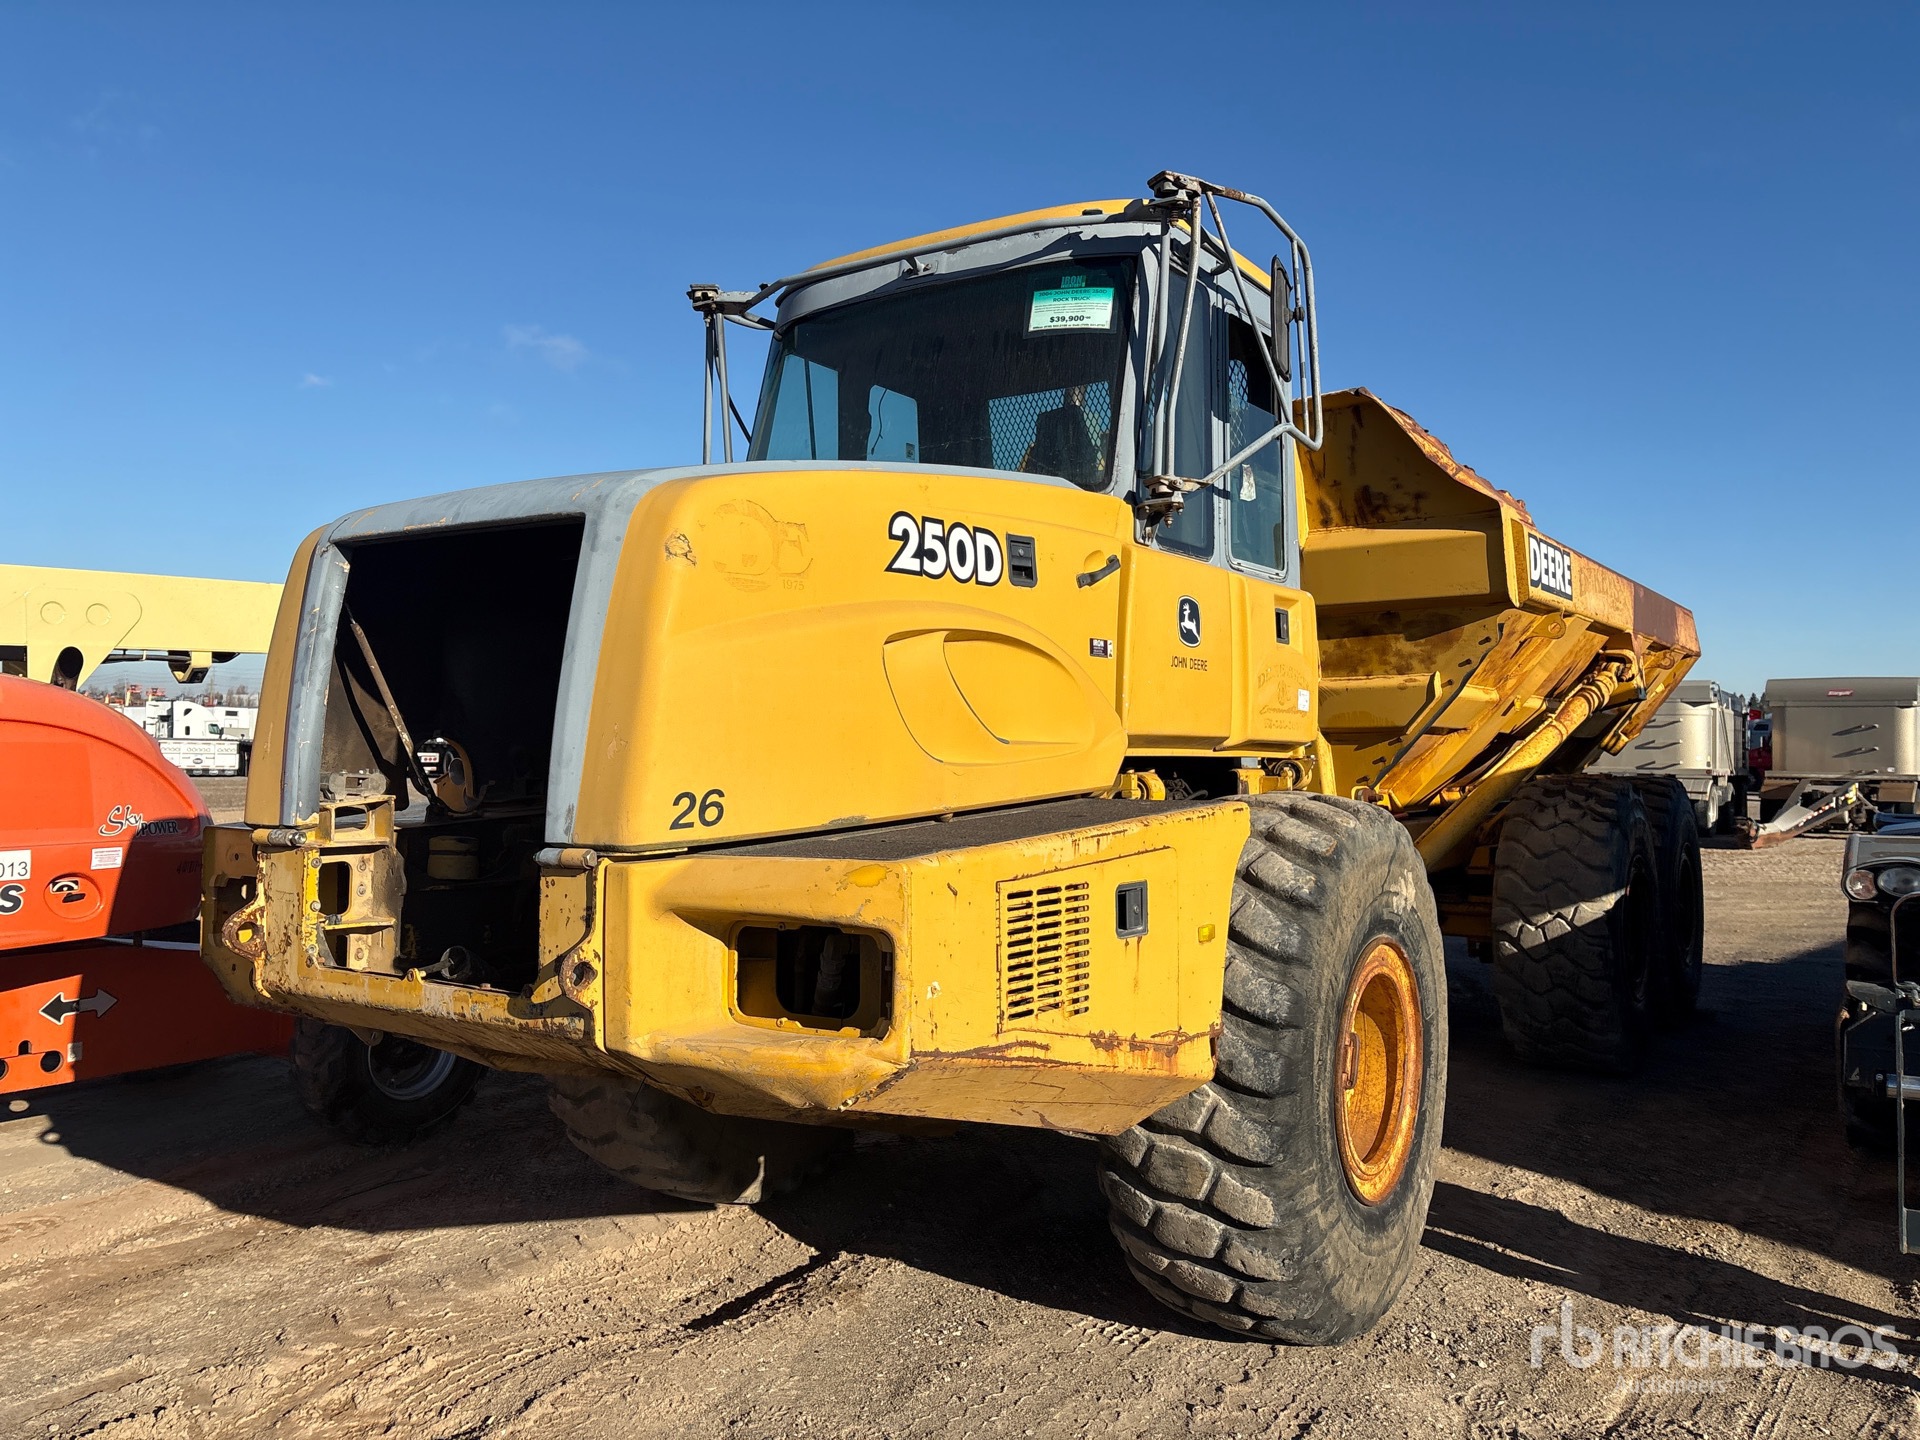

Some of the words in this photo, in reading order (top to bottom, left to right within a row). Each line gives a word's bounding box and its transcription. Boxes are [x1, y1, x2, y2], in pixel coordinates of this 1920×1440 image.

[885, 511, 1003, 586] 250D
[1528, 533, 1573, 600] DEERE
[1171, 655, 1188, 669] JOHN
[1189, 657, 1208, 672] DEERE
[669, 788, 725, 830] 26
